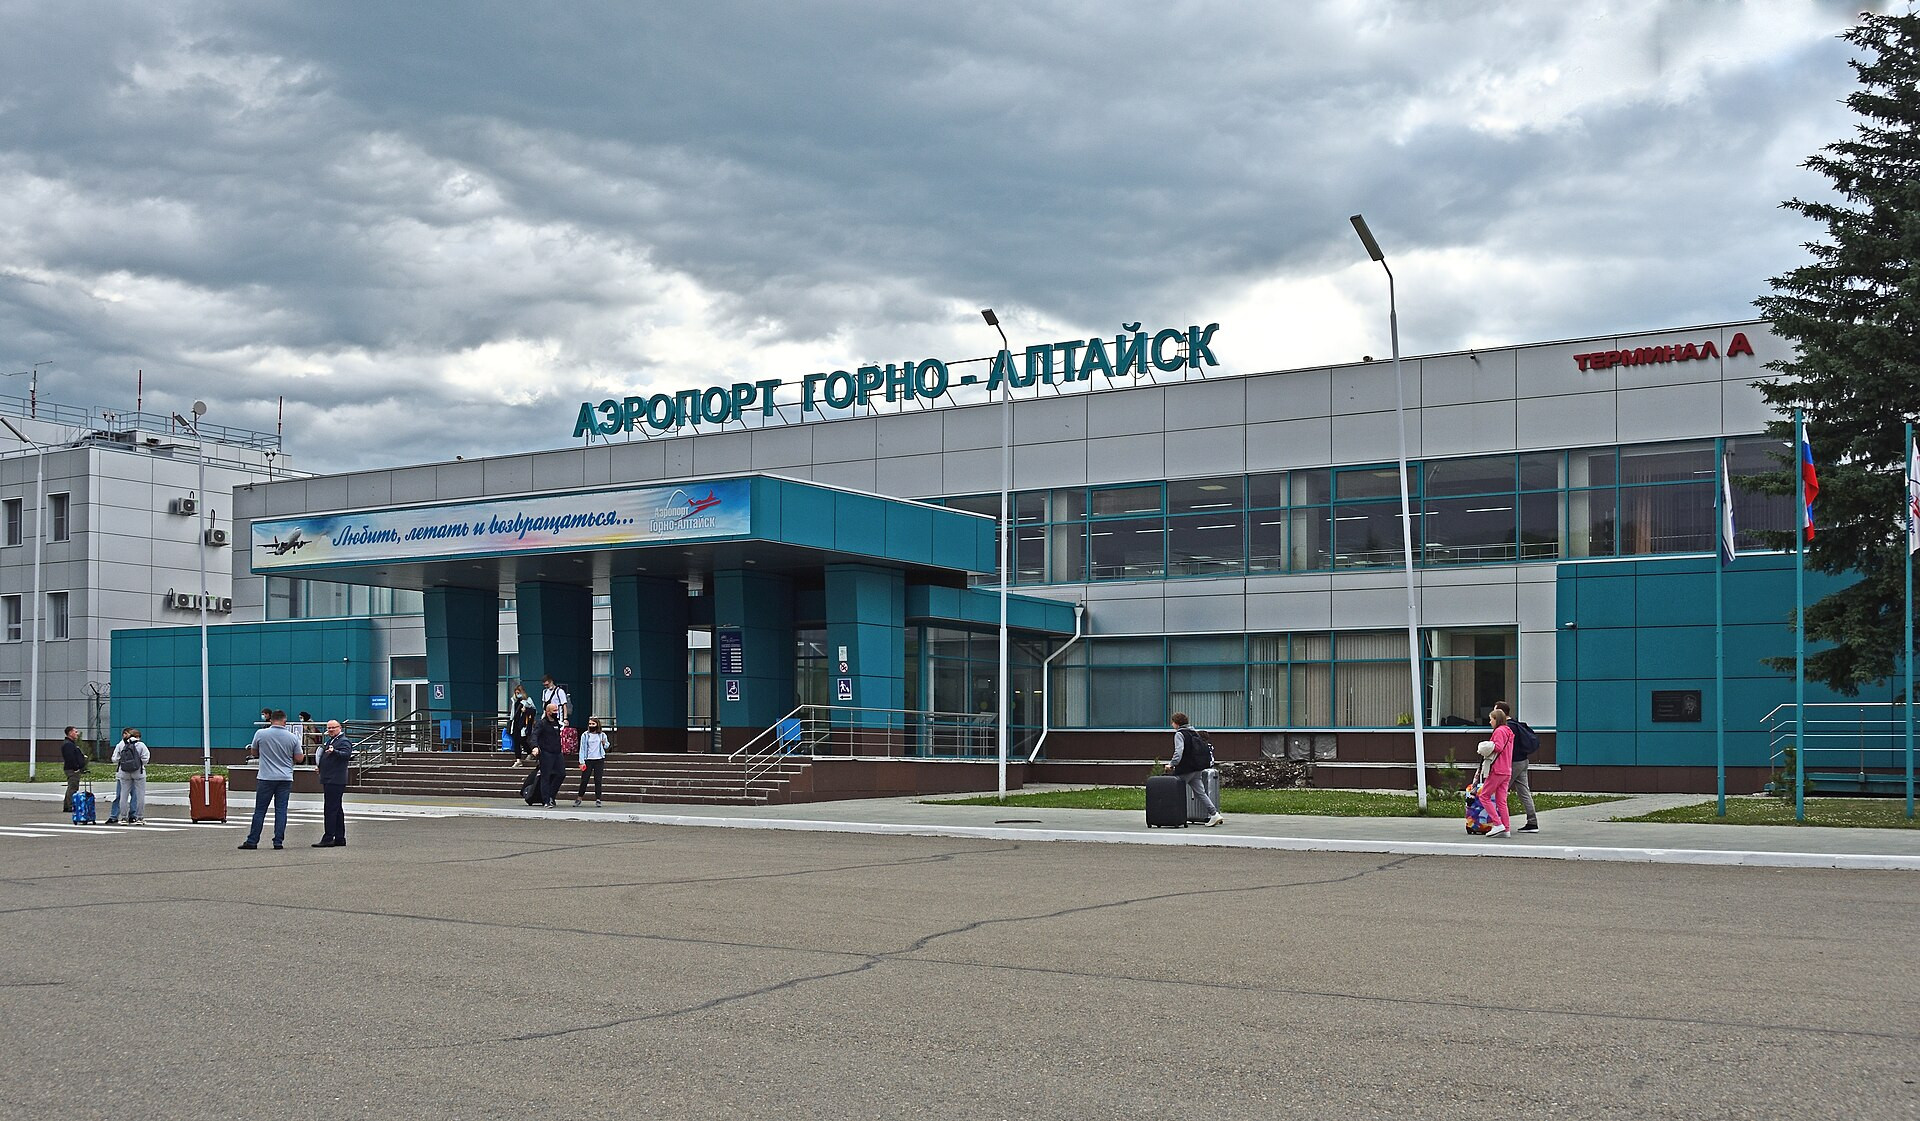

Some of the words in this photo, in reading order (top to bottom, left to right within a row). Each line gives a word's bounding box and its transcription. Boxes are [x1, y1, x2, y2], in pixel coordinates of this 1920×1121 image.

[1573, 340, 1720, 372] ТЕРМИНАЛ
[1727, 332, 1755, 358] А
[573, 379, 782, 438] АЭРОПОРТ
[804, 358, 949, 412] ГОРНО
[986, 322, 1220, 391] АЛТАЙСК
[332, 524, 402, 547] Любить,
[405, 521, 470, 541] летать
[473, 521, 486, 536] и
[488, 510, 634, 540] возвращаться...
[649, 515, 716, 534] Горно-Алтайск
[654, 506, 690, 519] Аэропорт
